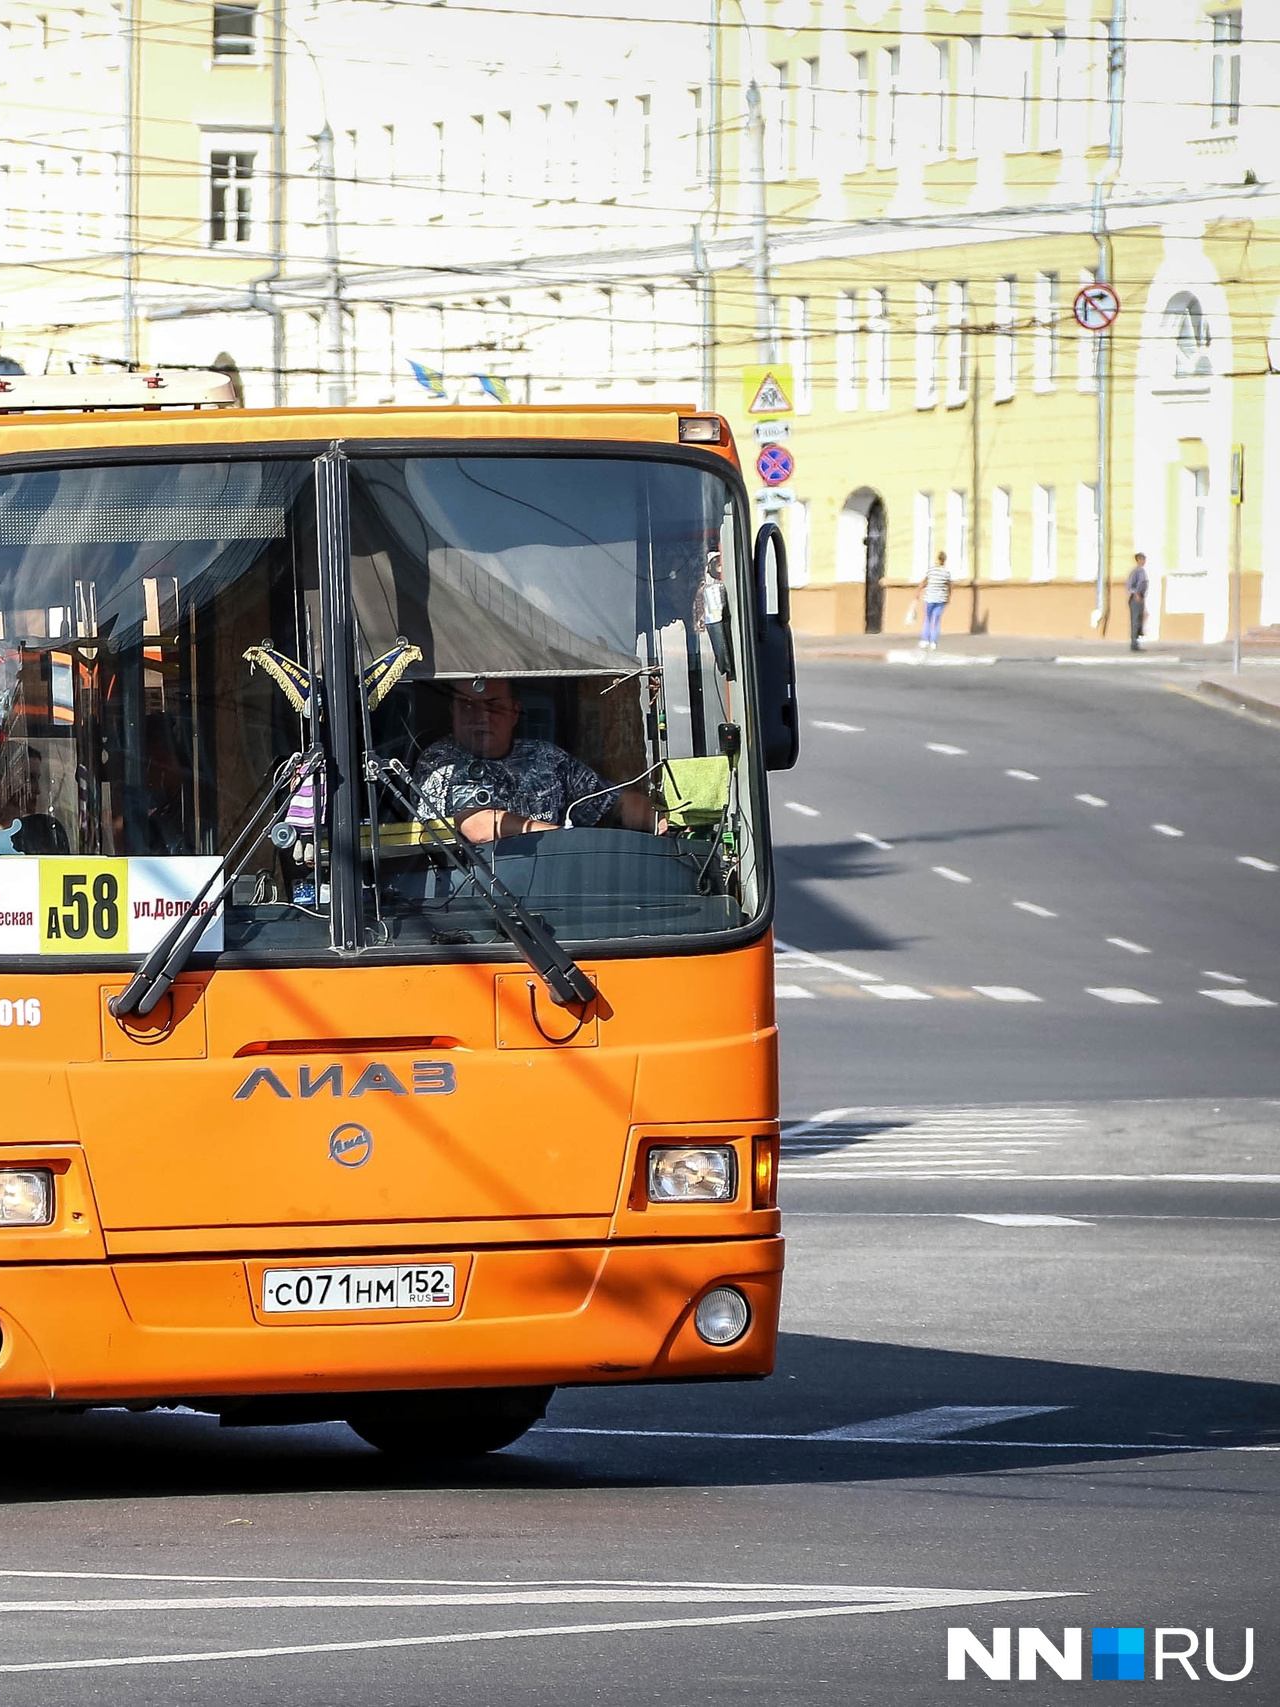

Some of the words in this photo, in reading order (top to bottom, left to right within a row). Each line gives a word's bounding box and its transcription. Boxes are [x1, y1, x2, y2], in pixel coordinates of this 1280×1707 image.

[232, 1060, 457, 1100] ЛИАЗ
[401, 1270, 445, 1293] 152
[409, 1293, 432, 1303] RUS
